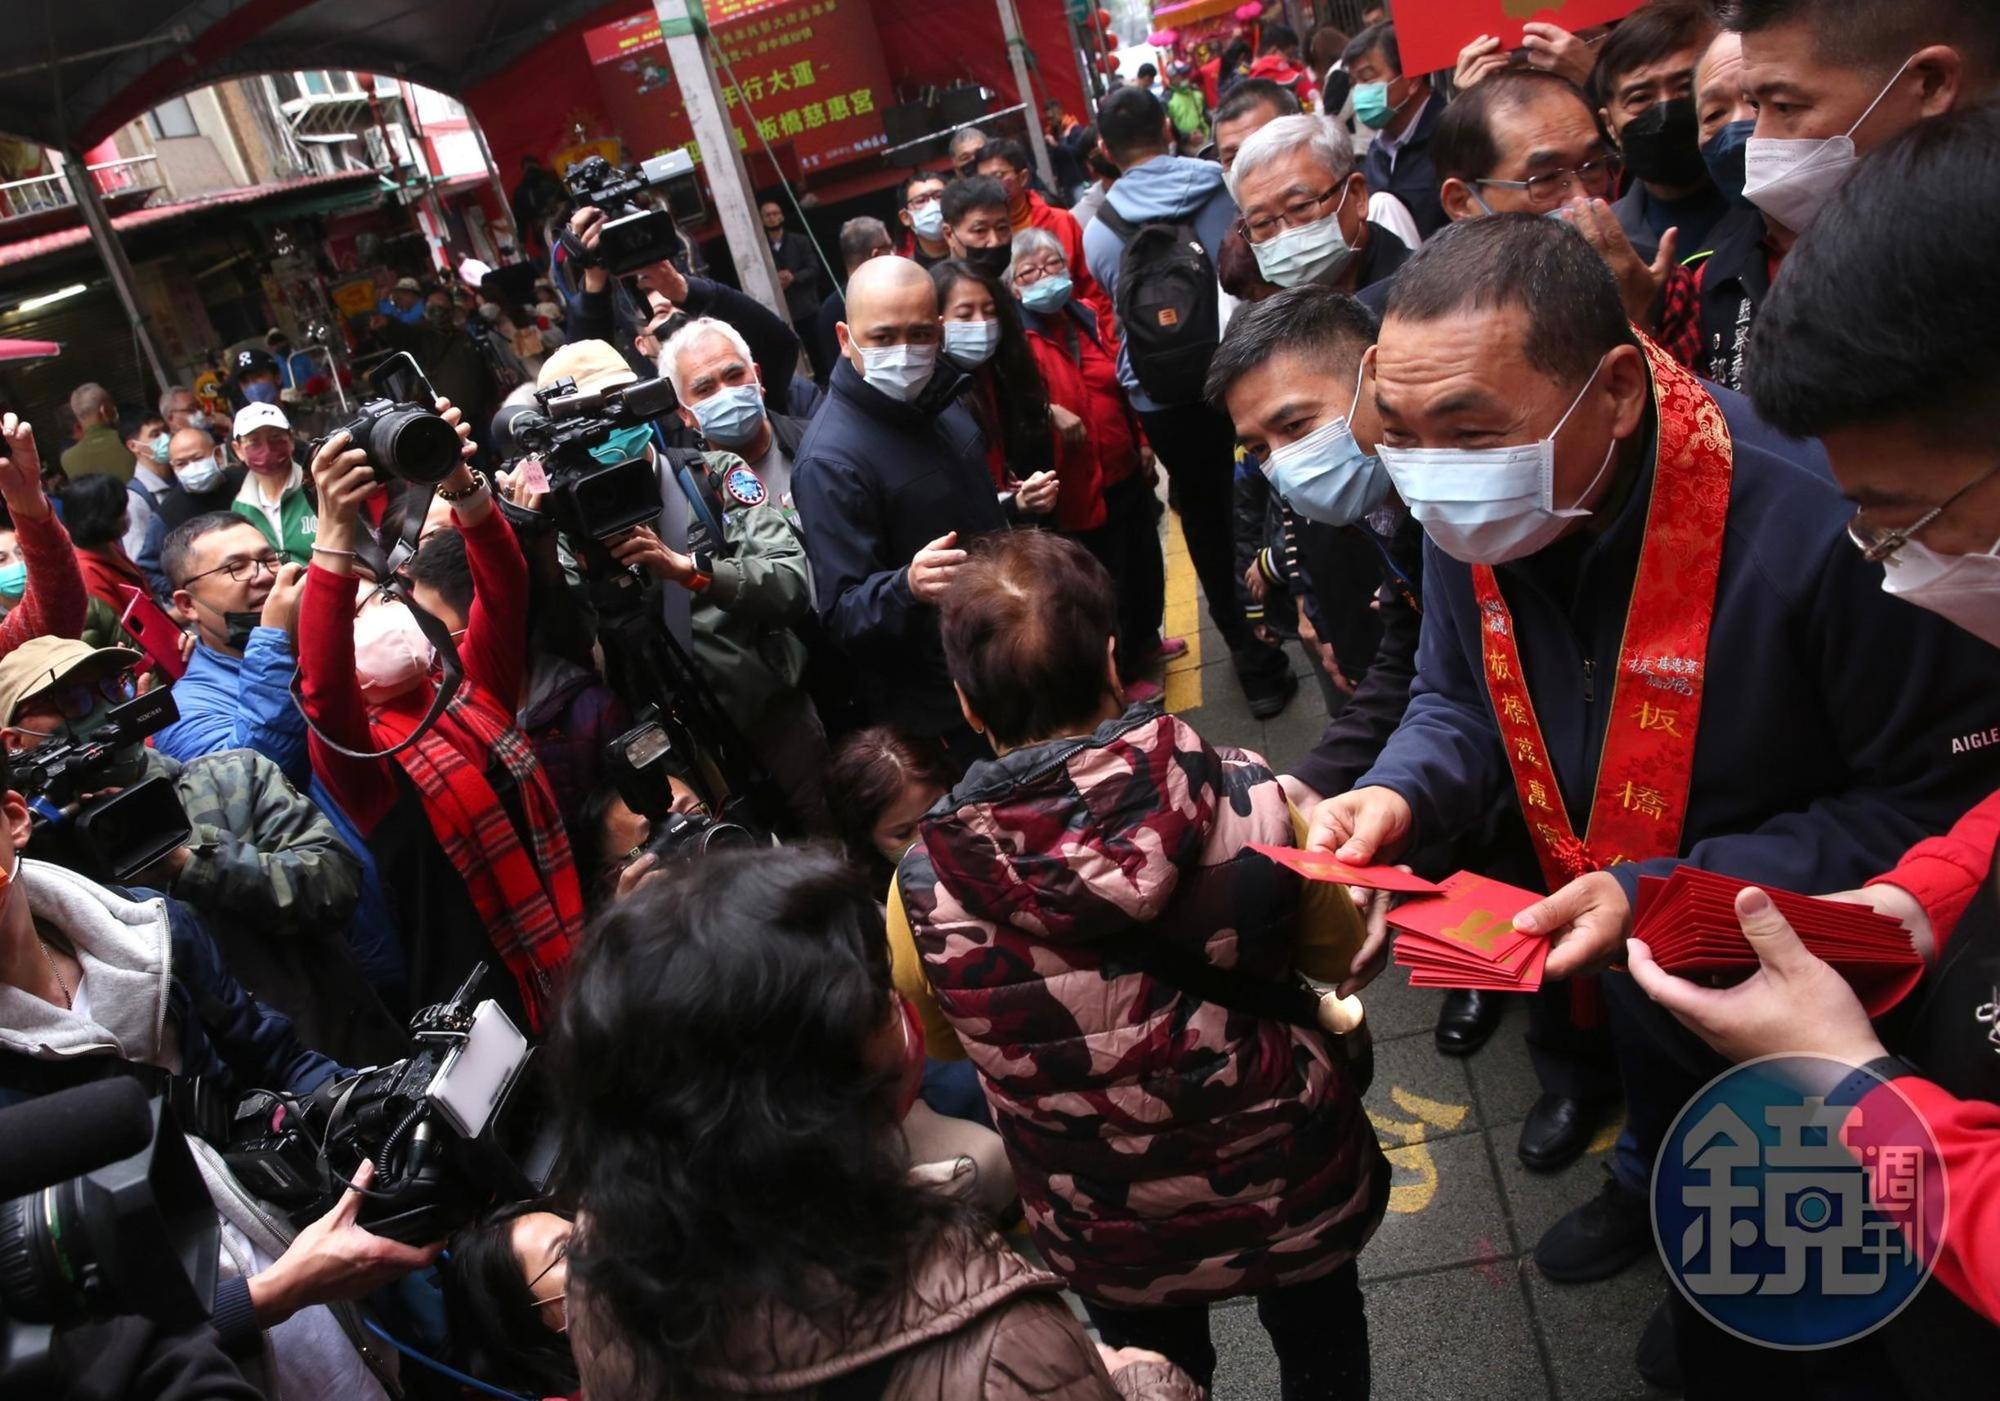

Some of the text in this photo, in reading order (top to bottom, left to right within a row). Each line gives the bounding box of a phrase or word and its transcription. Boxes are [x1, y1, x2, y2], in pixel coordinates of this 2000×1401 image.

[681, 60, 815, 108] 年行大運
[757, 89, 874, 141] 板橋慈惠宮
[1952, 728, 2000, 754] AIGLE
[1609, 701, 1682, 868] 板橋
